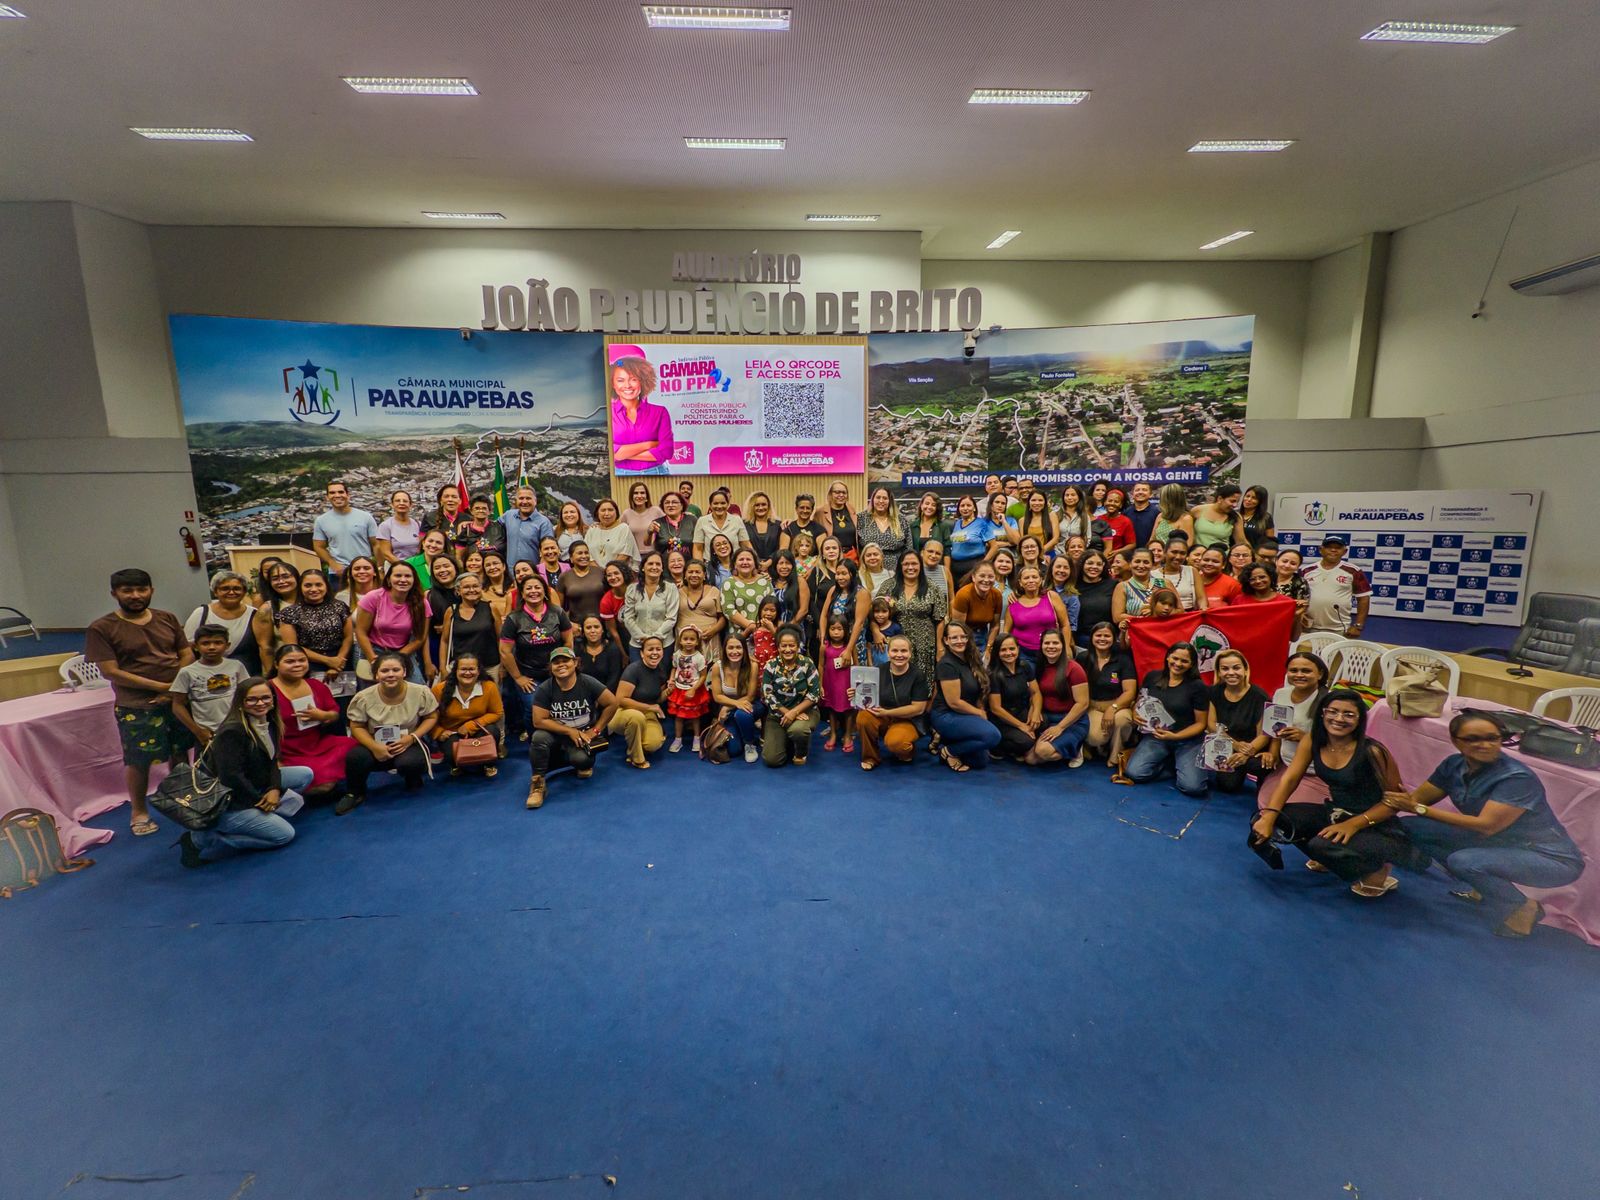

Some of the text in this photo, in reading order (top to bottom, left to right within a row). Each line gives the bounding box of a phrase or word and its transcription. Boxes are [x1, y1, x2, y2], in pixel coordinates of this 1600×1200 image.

[672, 248, 801, 282] AUDITÓRIO
[481, 278, 580, 331] JOÃO
[816, 292, 860, 334] DE
[871, 287, 982, 332] BRITO
[660, 360, 717, 378] CÂMARA
[745, 360, 840, 369] LEIA O QRCODE
[745, 370, 842, 379] E ACESSE O PPA
[398, 377, 506, 389] CÂMARA MUNICIPAL
[661, 375, 717, 393] NO PPA
[368, 389, 534, 409] PARAUAPEBAS
[772, 457, 834, 465] PARAUAPEBAS
[1084, 473, 1112, 482] COM
[1114, 472, 1122, 482] A
[1125, 472, 1161, 481] NOSSA
[1166, 471, 1202, 481] GENTE
[1339, 512, 1425, 521] PARAUAPEBAS
[563, 698, 590, 711] SOLA
